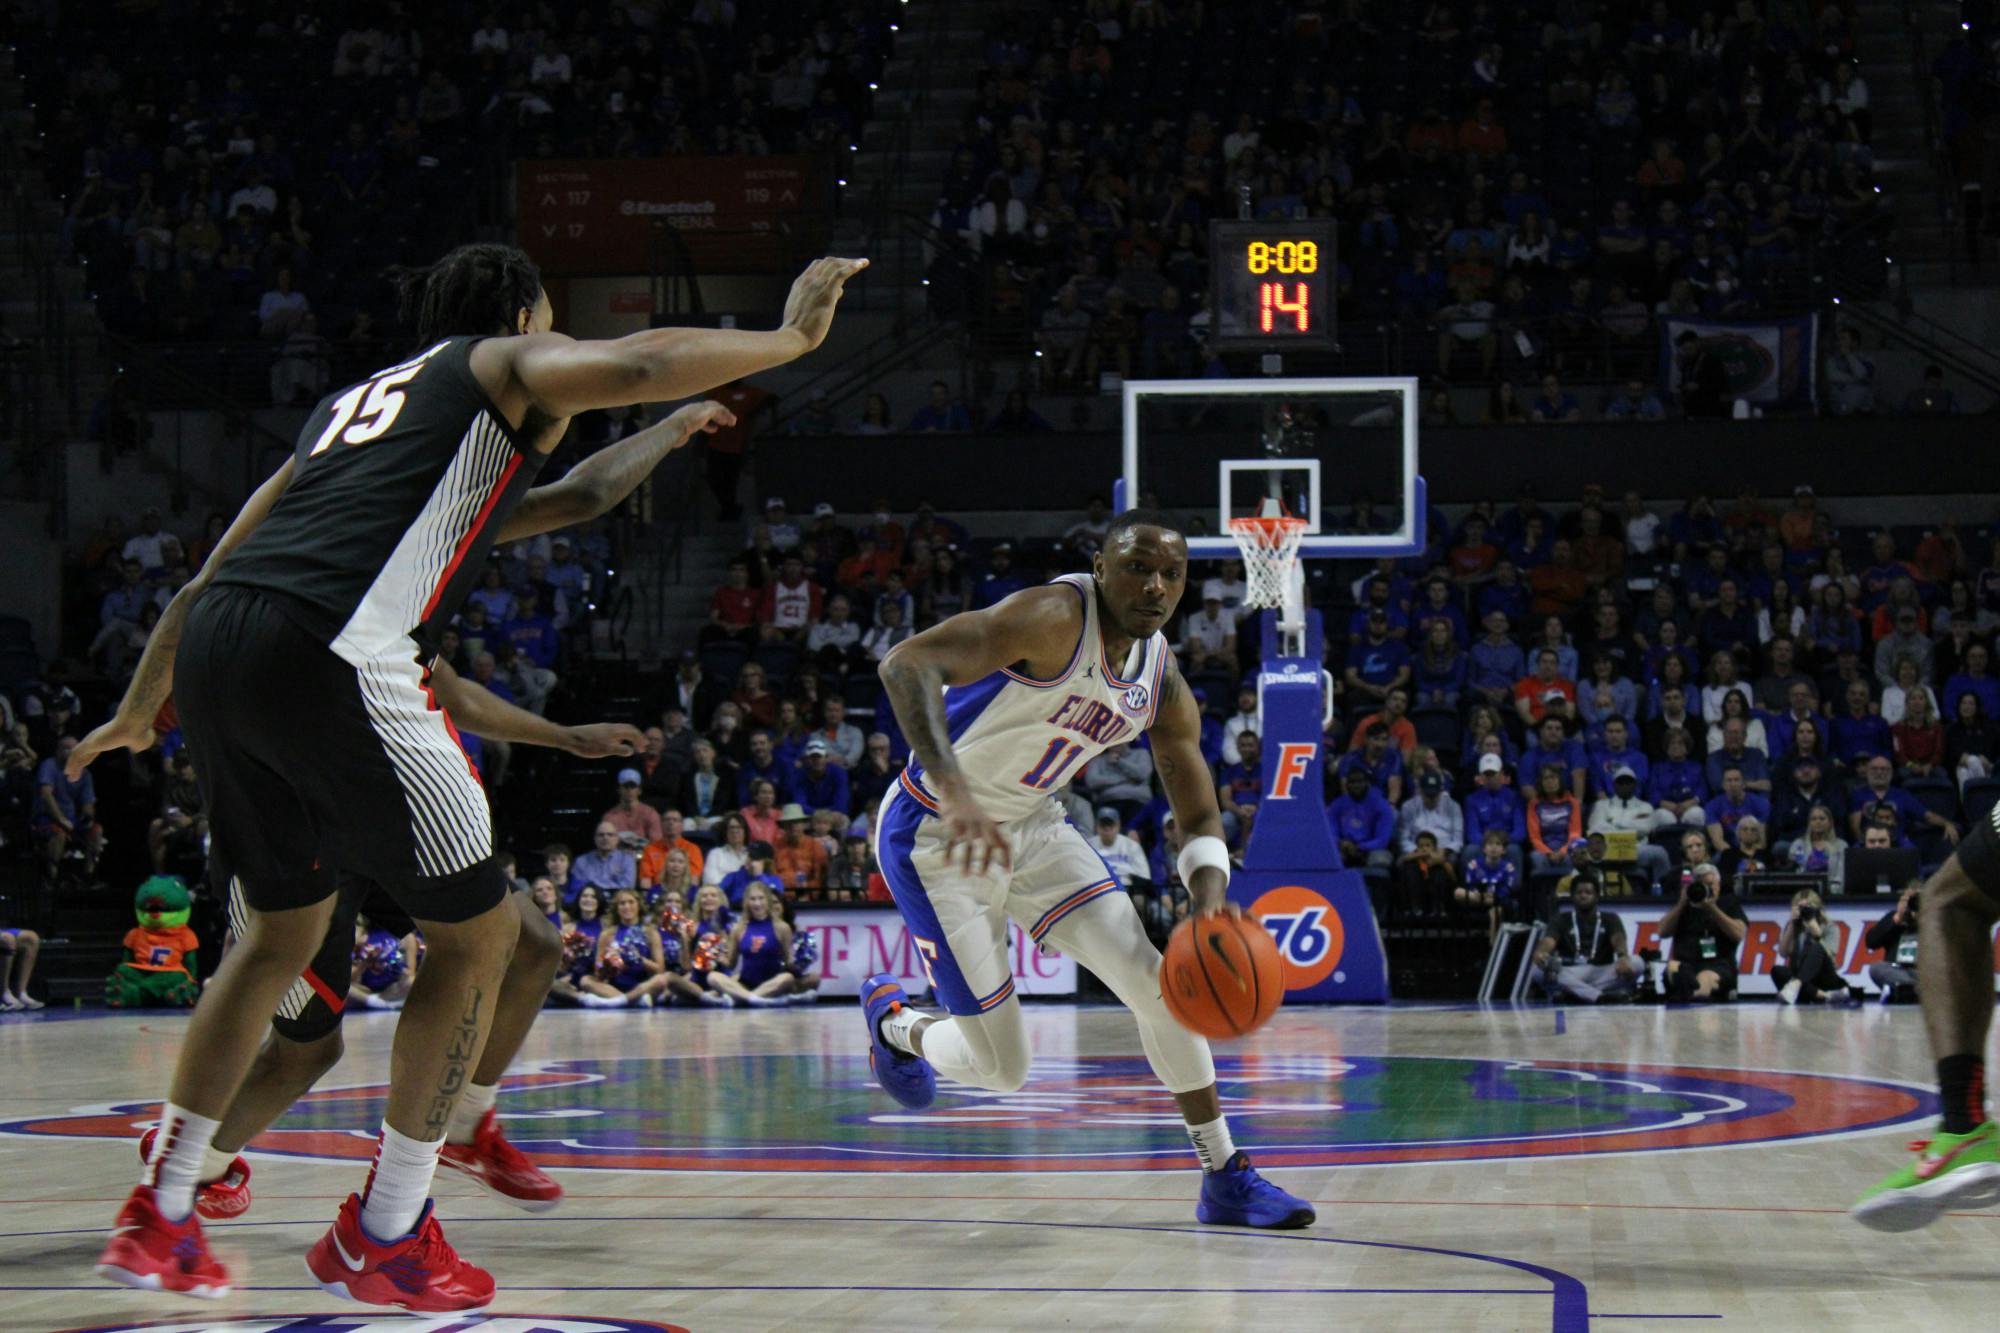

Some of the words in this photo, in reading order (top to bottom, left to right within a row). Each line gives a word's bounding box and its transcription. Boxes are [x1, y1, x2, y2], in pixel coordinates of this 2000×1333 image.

[567, 190, 592, 206] 117
[744, 187, 769, 203] 119
[1248, 241, 1317, 273] 8:08
[1261, 282, 1309, 332] 14
[309, 363, 426, 457] 15
[1047, 694, 1133, 745] FLORD
[1020, 736, 1085, 789] 11
[1266, 743, 1317, 800] F
[1260, 906, 1332, 967] 76
